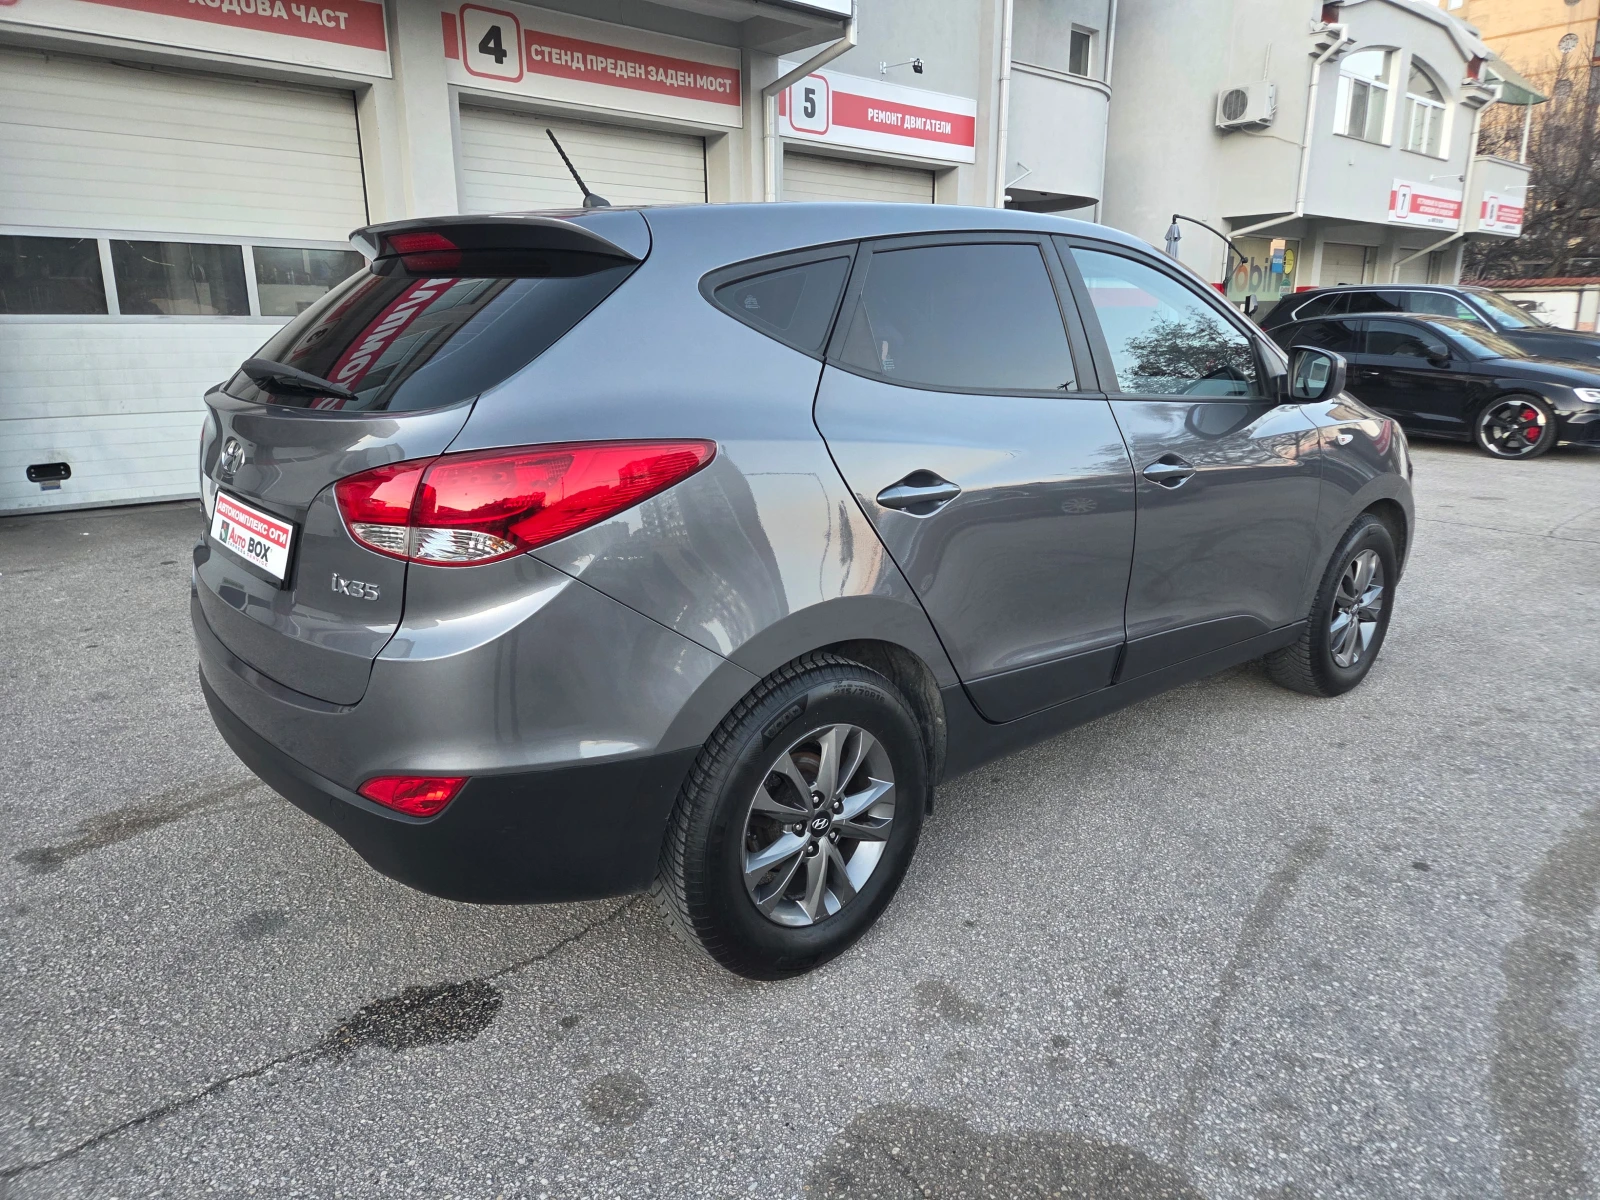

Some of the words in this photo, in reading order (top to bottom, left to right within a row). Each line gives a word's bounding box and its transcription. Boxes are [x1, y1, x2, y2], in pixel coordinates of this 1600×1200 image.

[291, 3, 349, 30] ЧАСТ
[478, 25, 507, 65] 4
[530, 44, 584, 71] СТЕНД
[586, 54, 645, 79] ПРЕДЕН
[647, 66, 694, 88] ЗАДЕН
[696, 74, 732, 93] МОСТ
[803, 87, 816, 118] 5
[868, 108, 902, 126] РЕМОНТ
[904, 115, 951, 134] ДВИГАТЕЛИ
[217, 501, 268, 535] АВТОКОМПЛЕКС
[269, 528, 287, 544] ОГИ
[248, 537, 270, 562] BOX
[332, 572, 380, 601] ix35
